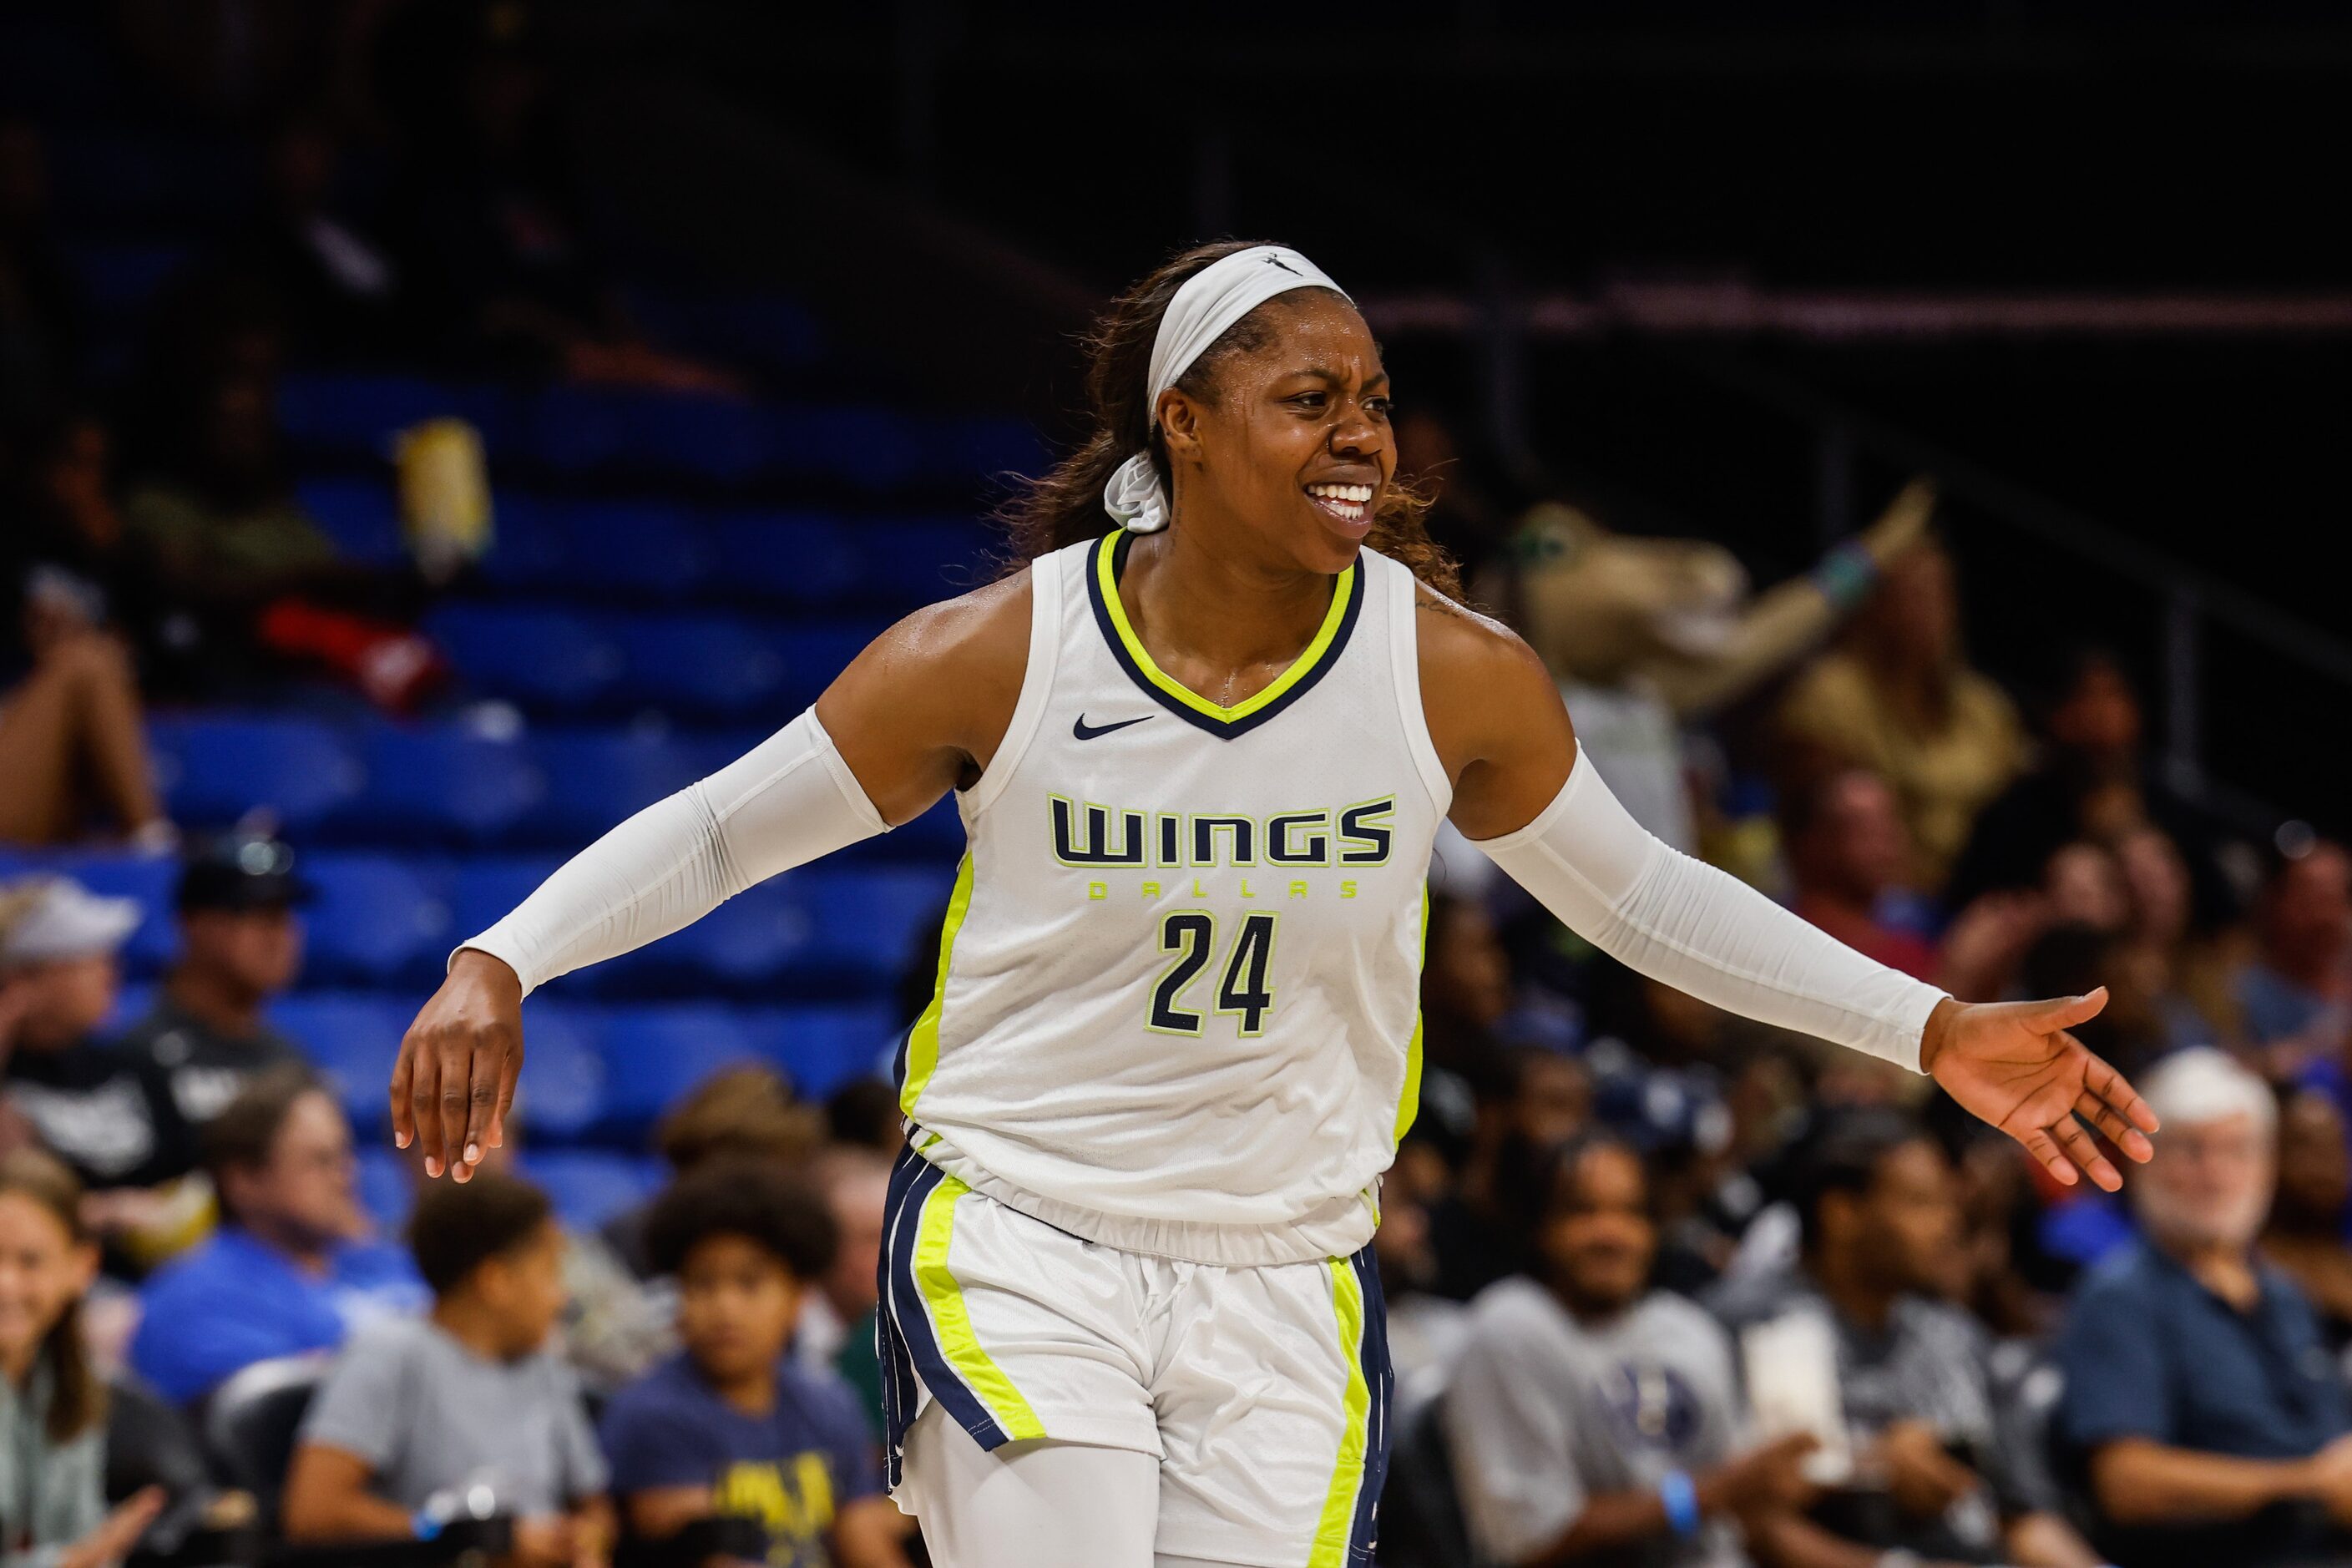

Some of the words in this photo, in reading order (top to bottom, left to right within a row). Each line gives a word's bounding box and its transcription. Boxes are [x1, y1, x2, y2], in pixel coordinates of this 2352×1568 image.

[1048, 792, 1396, 867] WINGS
[1089, 878, 1358, 899] DALLAS
[1144, 909, 1281, 1038] 24
